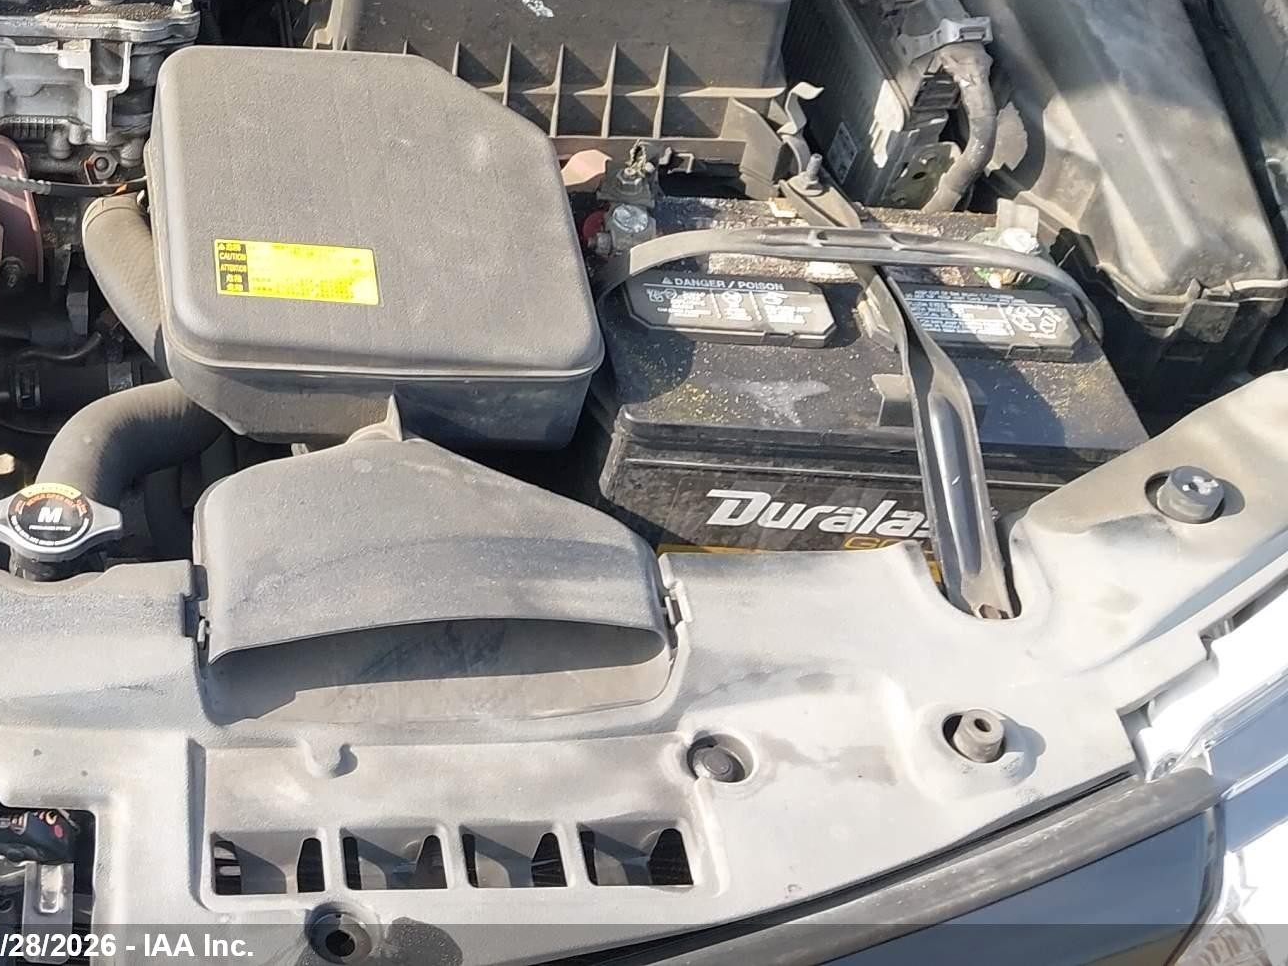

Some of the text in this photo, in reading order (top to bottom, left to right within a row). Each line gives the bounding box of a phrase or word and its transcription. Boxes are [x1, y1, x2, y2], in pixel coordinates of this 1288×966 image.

[674, 277, 726, 289] DANGER
[738, 281, 784, 291] POISON
[706, 489, 931, 538] Durala
